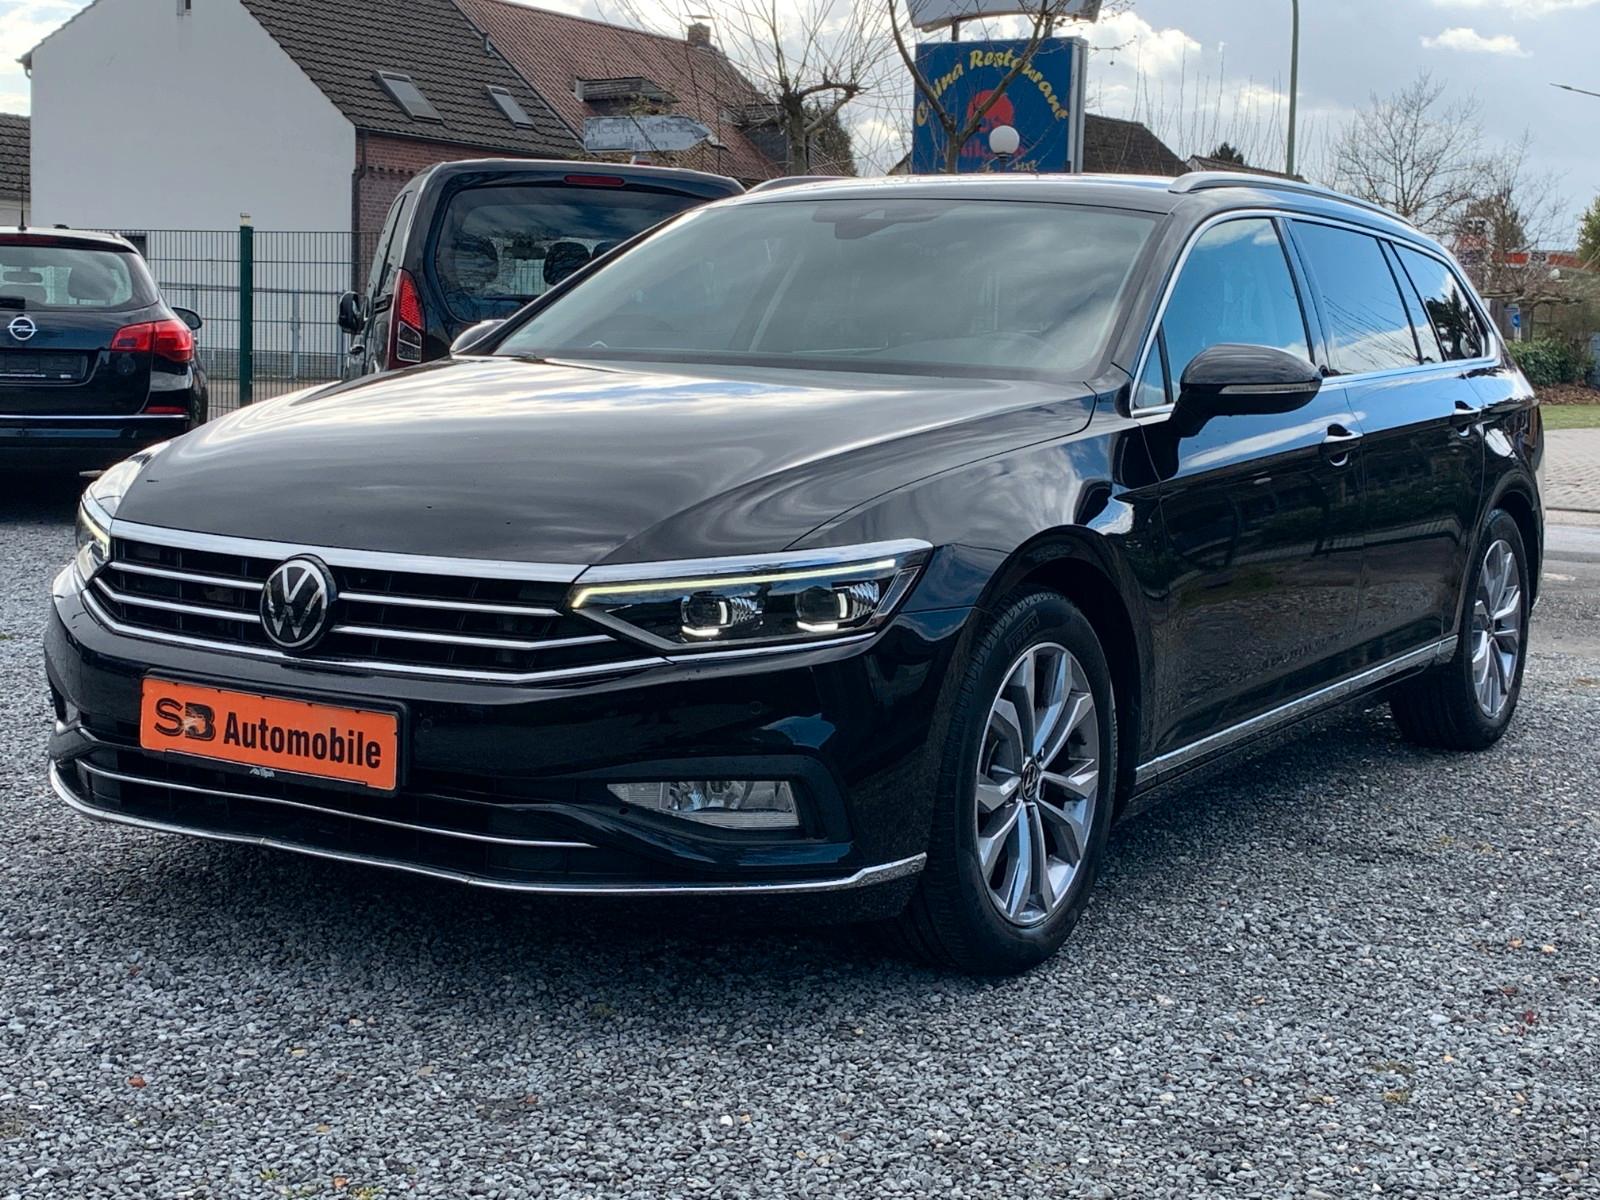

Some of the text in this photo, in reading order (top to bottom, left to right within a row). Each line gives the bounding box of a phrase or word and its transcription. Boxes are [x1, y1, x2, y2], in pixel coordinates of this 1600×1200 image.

[916, 62, 964, 127] Cina
[154, 697, 382, 769] SB Automobile
